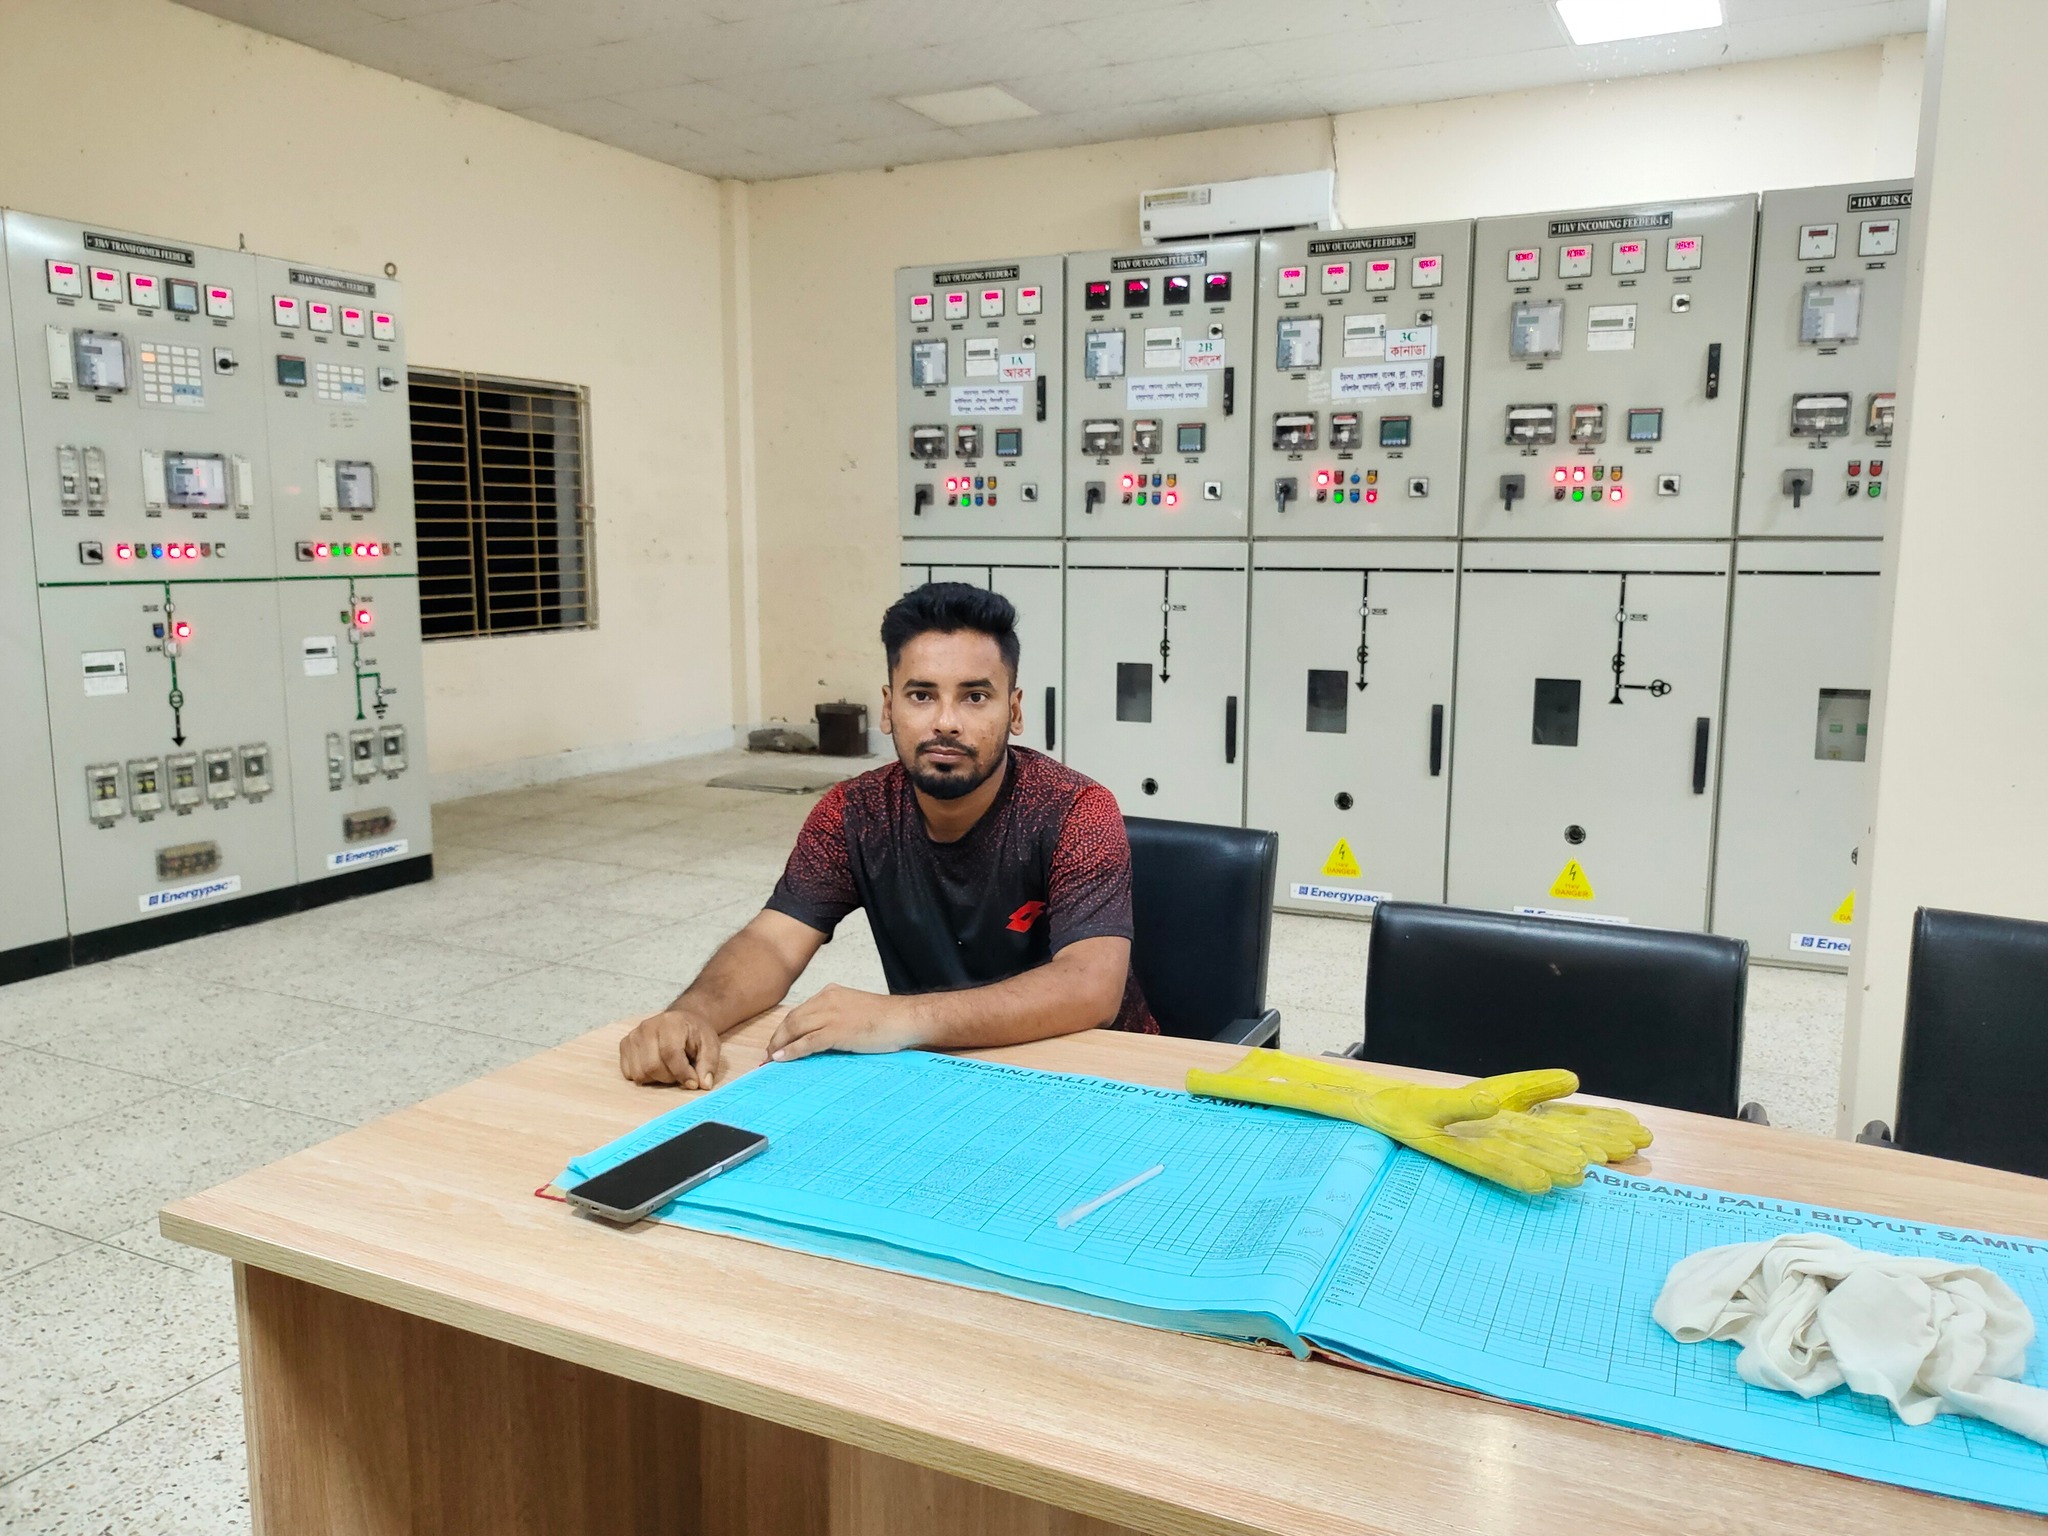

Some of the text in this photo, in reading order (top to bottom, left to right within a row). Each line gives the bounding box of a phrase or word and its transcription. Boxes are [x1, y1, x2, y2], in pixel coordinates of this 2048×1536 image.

[1880, 194, 1900, 205] BUS
[1577, 219, 1622, 232] INCOMING
[111, 240, 160, 258] TRANSFORMER
[160, 250, 186, 262] FEEDER
[1331, 239, 1372, 251] OUTGOING
[1132, 257, 1167, 268] OUTGOING
[313, 276, 346, 289] INCOMING
[952, 272, 985, 282] OUTGOING
[1400, 331, 1417, 343] 3C
[1198, 342, 1213, 352] 2B
[1011, 356, 1024, 365] 1A
[345, 845, 399, 862] Energypac
[1326, 867, 1357, 875] DANGER
[161, 882, 228, 903] Energypac
[1310, 887, 1379, 903] Energypac
[1555, 889, 1589, 897] DANGER
[928, 1057, 1034, 1077] HABIGANJ
[1037, 1074, 1098, 1086] PALLI
[1101, 1082, 1185, 1101] BIDYUT
[981, 1072, 1027, 1083] STATION
[1062, 1083, 1087, 1091] LOG
[1088, 1088, 1127, 1099] SHEET
[1584, 1170, 1708, 1201] ABIGANJ
[1719, 1196, 1801, 1216] PALLI
[1811, 1210, 1927, 1236] BIDYUT
[1648, 1195, 1711, 1210] STATION
[1716, 1206, 1760, 1217] DAILY
[1765, 1214, 1799, 1224] LOG
[1804, 1221, 1857, 1234] SHEET
[1972, 1248, 2011, 1259] Station
